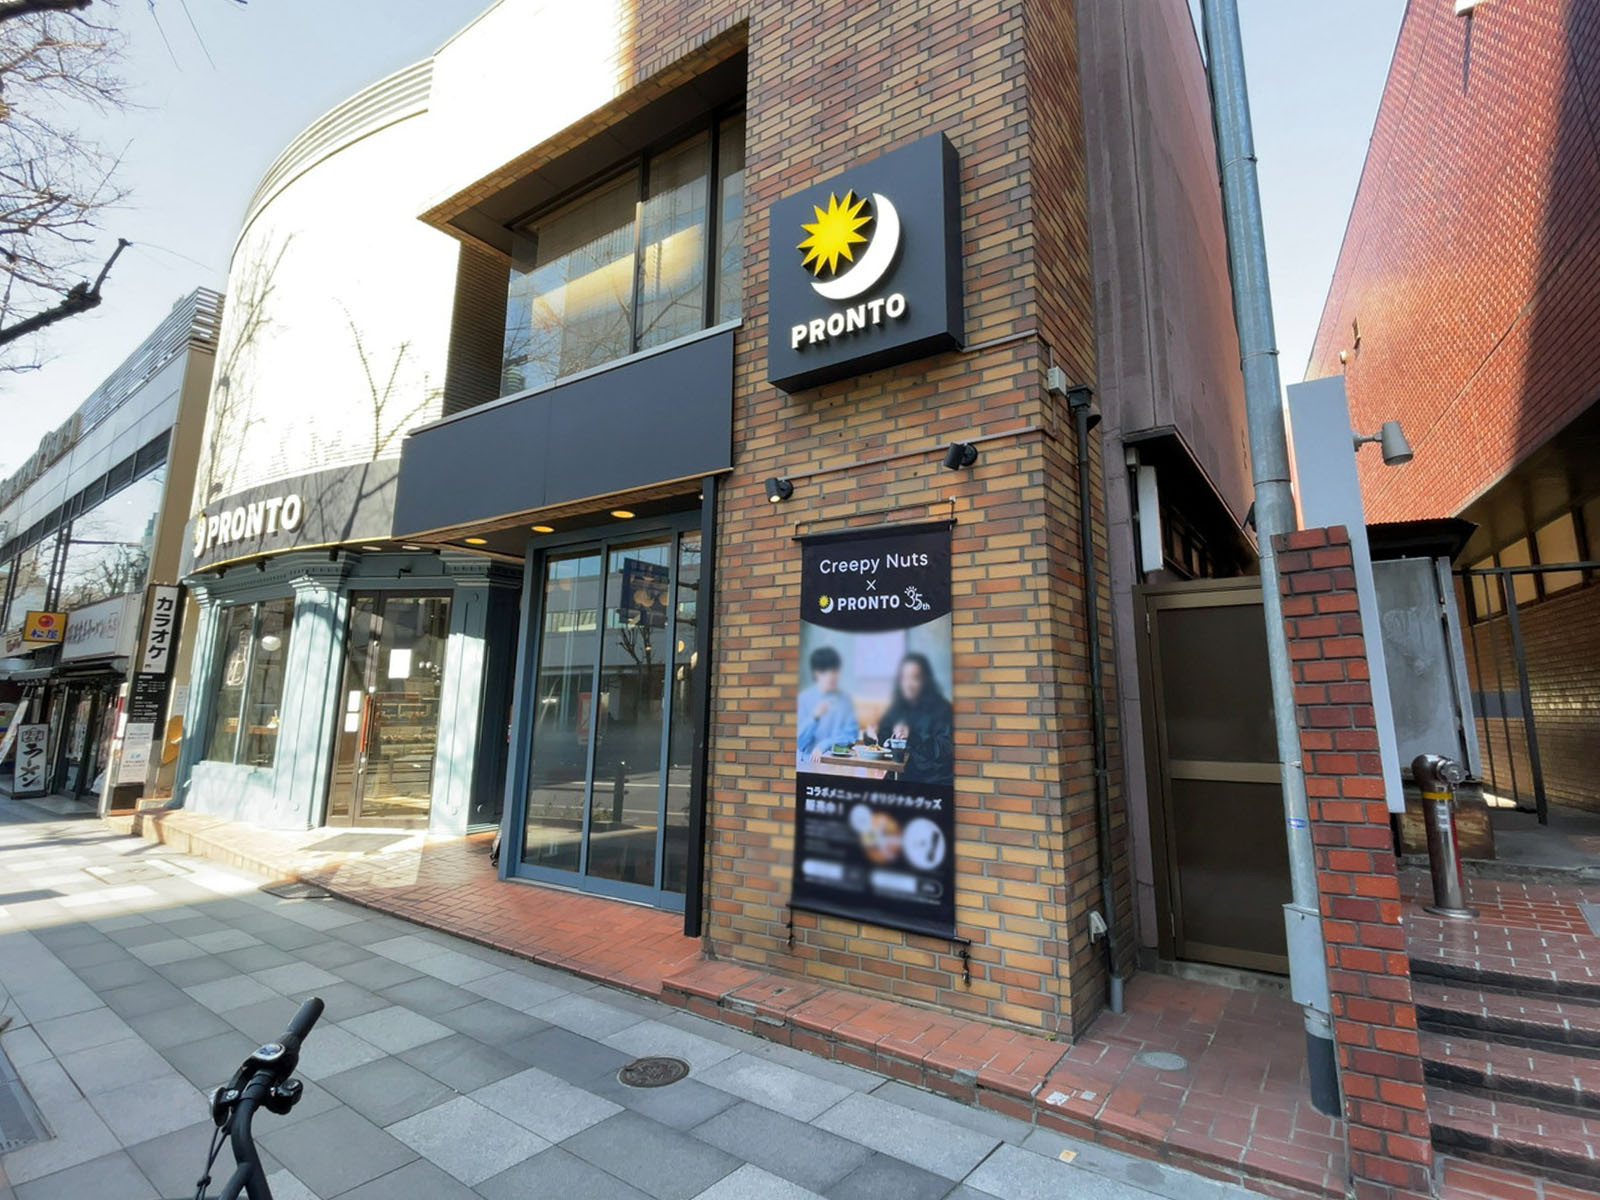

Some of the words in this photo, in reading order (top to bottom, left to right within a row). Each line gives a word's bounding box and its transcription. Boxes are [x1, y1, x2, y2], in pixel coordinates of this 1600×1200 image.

[791, 293, 906, 349] PRONTO
[207, 495, 301, 548] PRONTO
[819, 558, 880, 574] Creepy
[886, 552, 928, 568] Nuts
[837, 594, 900, 611] PRONTO
[148, 597, 173, 659] カラオケ
[17, 743, 43, 787] ラーメン
